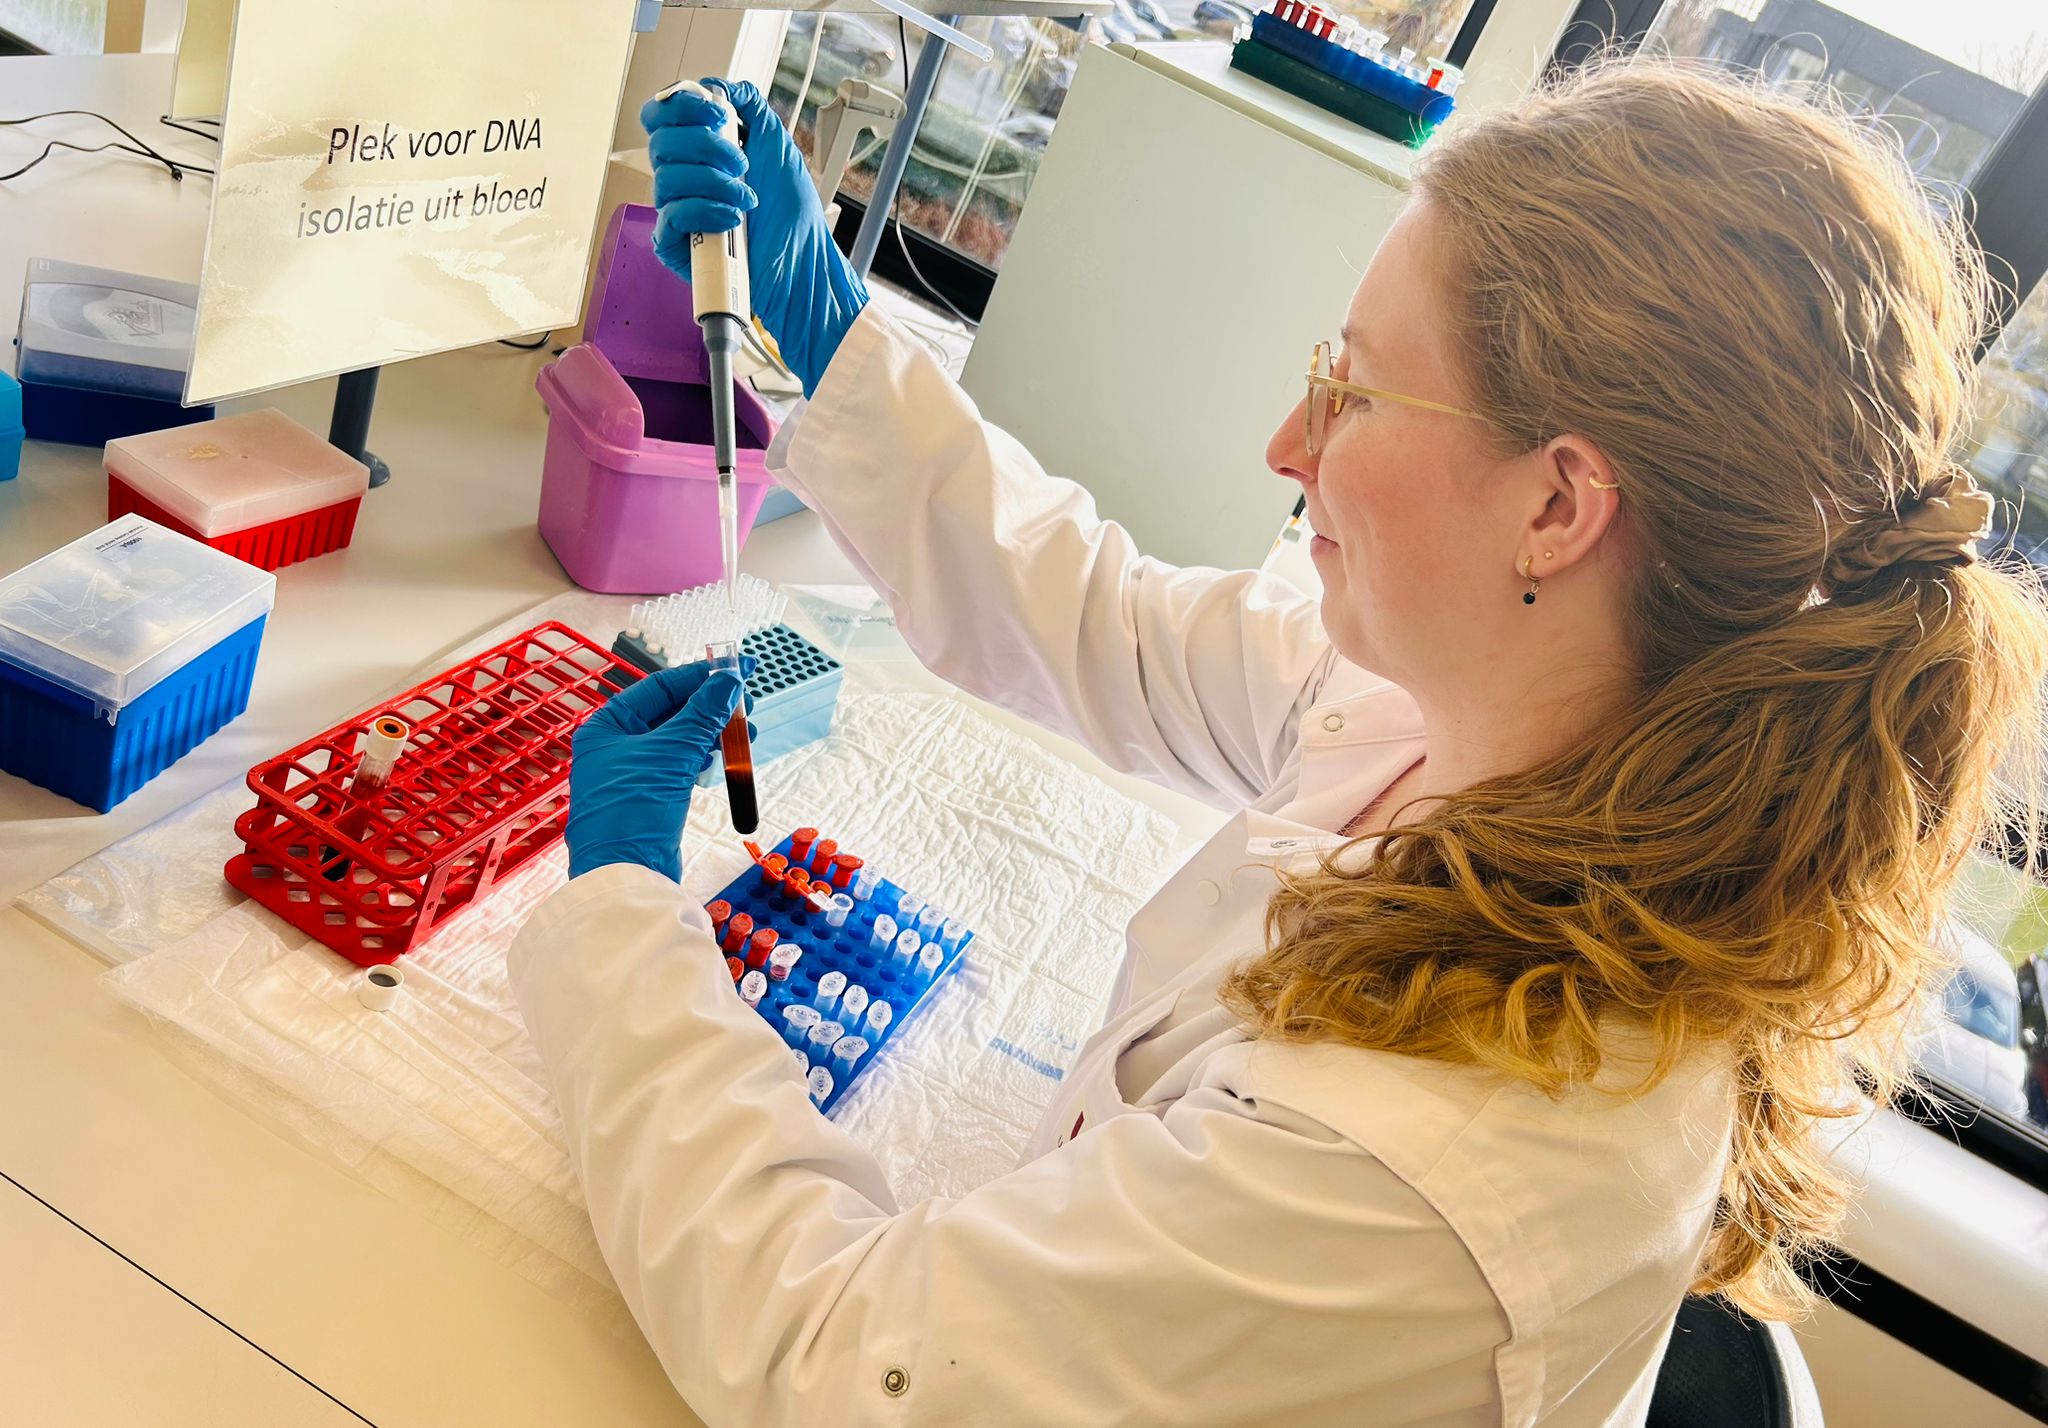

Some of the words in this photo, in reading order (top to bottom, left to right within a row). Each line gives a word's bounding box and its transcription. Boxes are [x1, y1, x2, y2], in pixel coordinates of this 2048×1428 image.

[328, 123, 398, 165] Plek
[408, 129, 477, 159] voor
[483, 118, 542, 153] DNA
[297, 193, 414, 238] isolatie
[424, 187, 464, 222] uit
[470, 177, 547, 216] bloed
